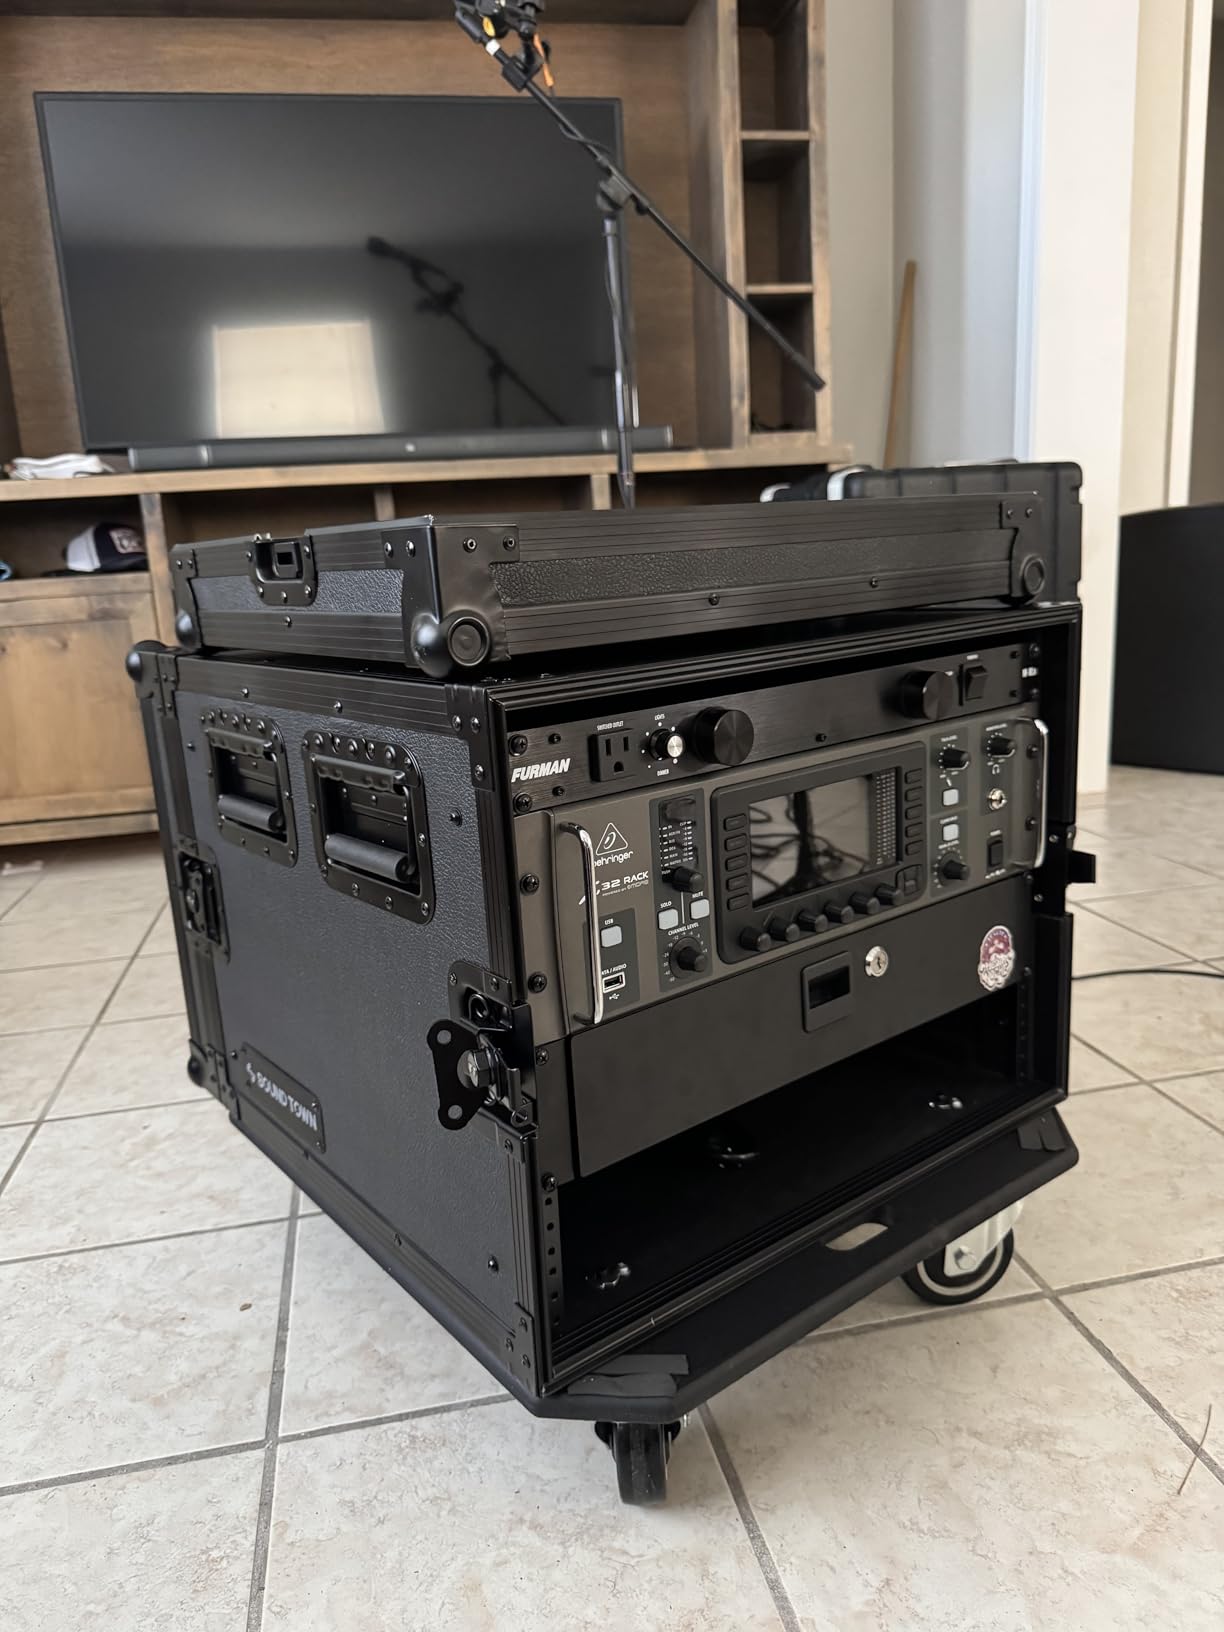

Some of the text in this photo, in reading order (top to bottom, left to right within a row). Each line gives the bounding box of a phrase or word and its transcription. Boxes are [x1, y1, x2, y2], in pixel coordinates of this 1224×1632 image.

[511, 757, 571, 783] FURMAN
[623, 870, 649, 885] RACK
[660, 900, 672, 909] SOLO
[604, 918, 614, 926] USB
[256, 1071, 288, 1108] SOUND
